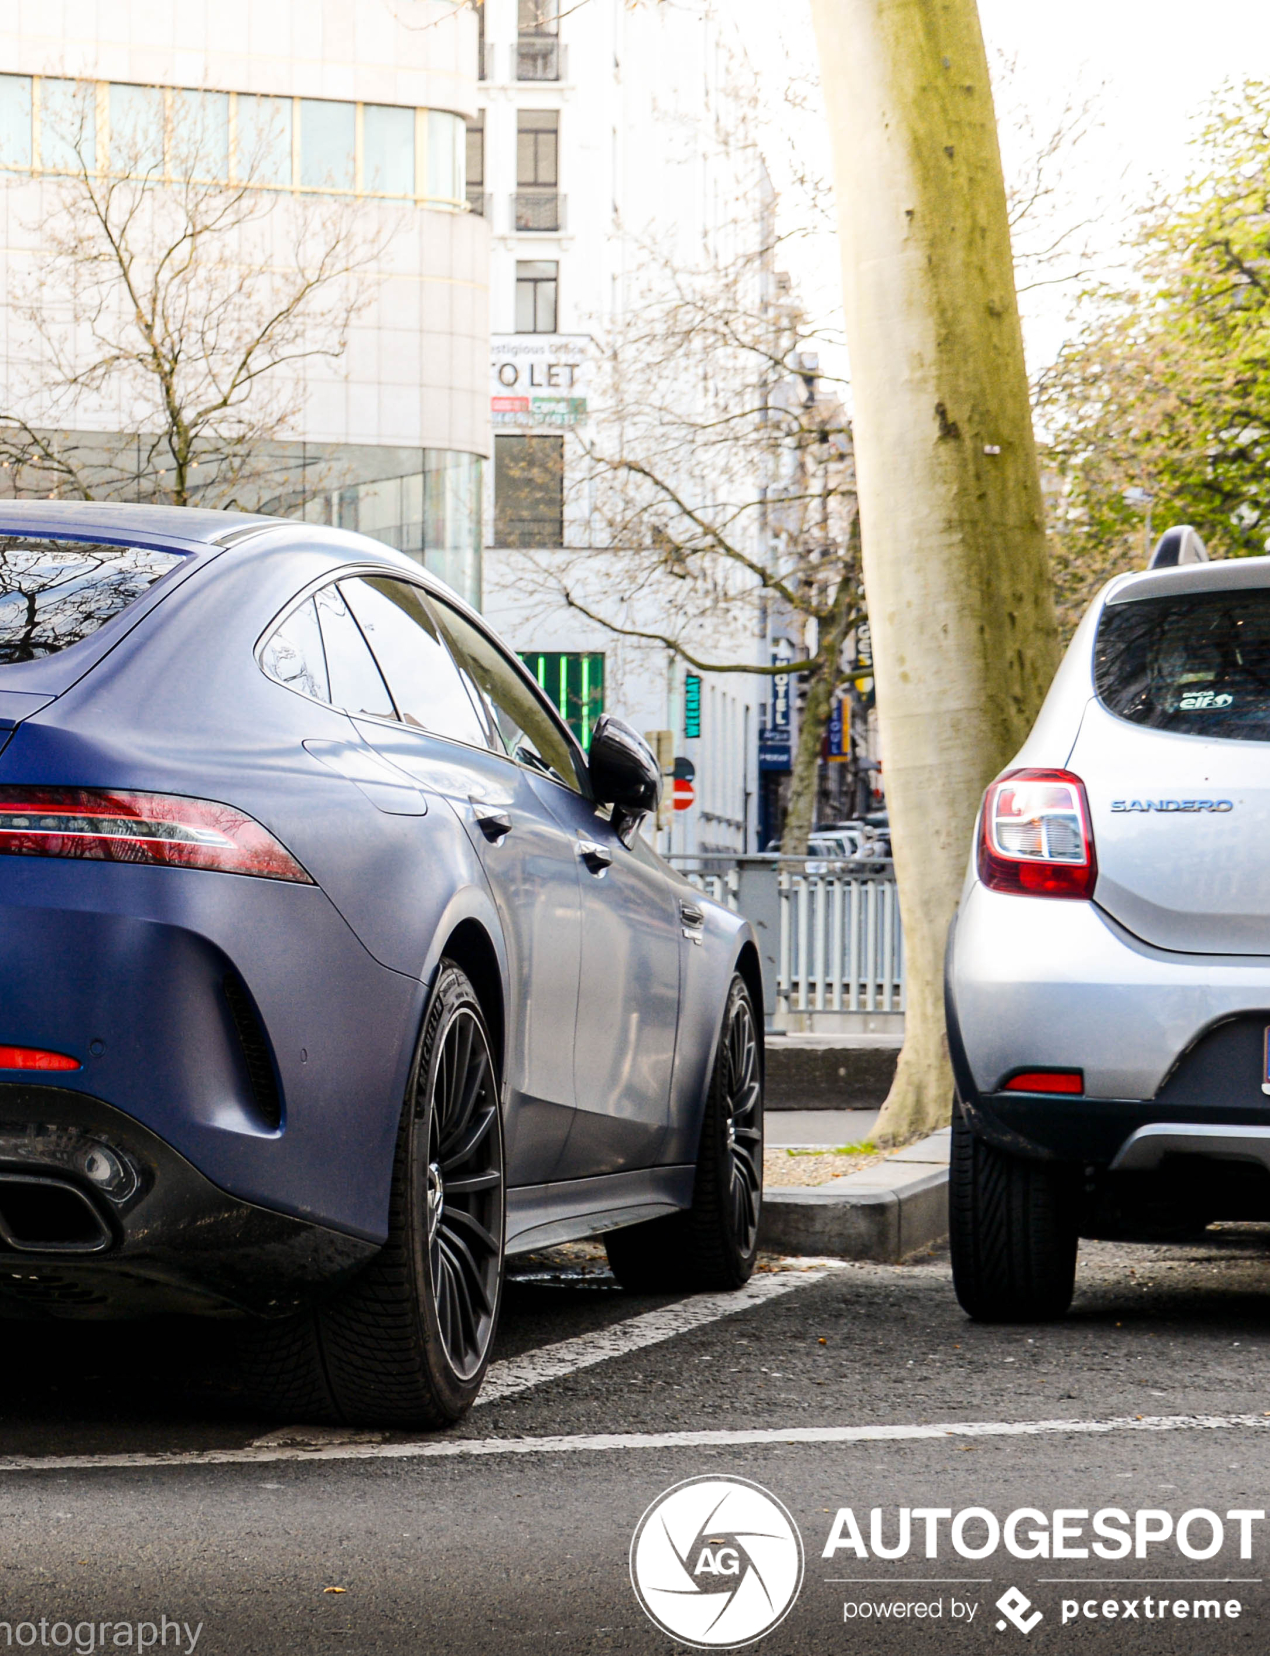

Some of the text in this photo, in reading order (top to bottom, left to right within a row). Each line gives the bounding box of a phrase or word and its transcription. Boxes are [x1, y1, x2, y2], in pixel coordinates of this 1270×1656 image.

[530, 363, 580, 388] LET
[686, 677, 700, 737] WEEKDAY
[1180, 696, 1215, 709] elf
[1110, 799, 1234, 813] SANDERO
[419, 996, 444, 1091] MICHELIN
